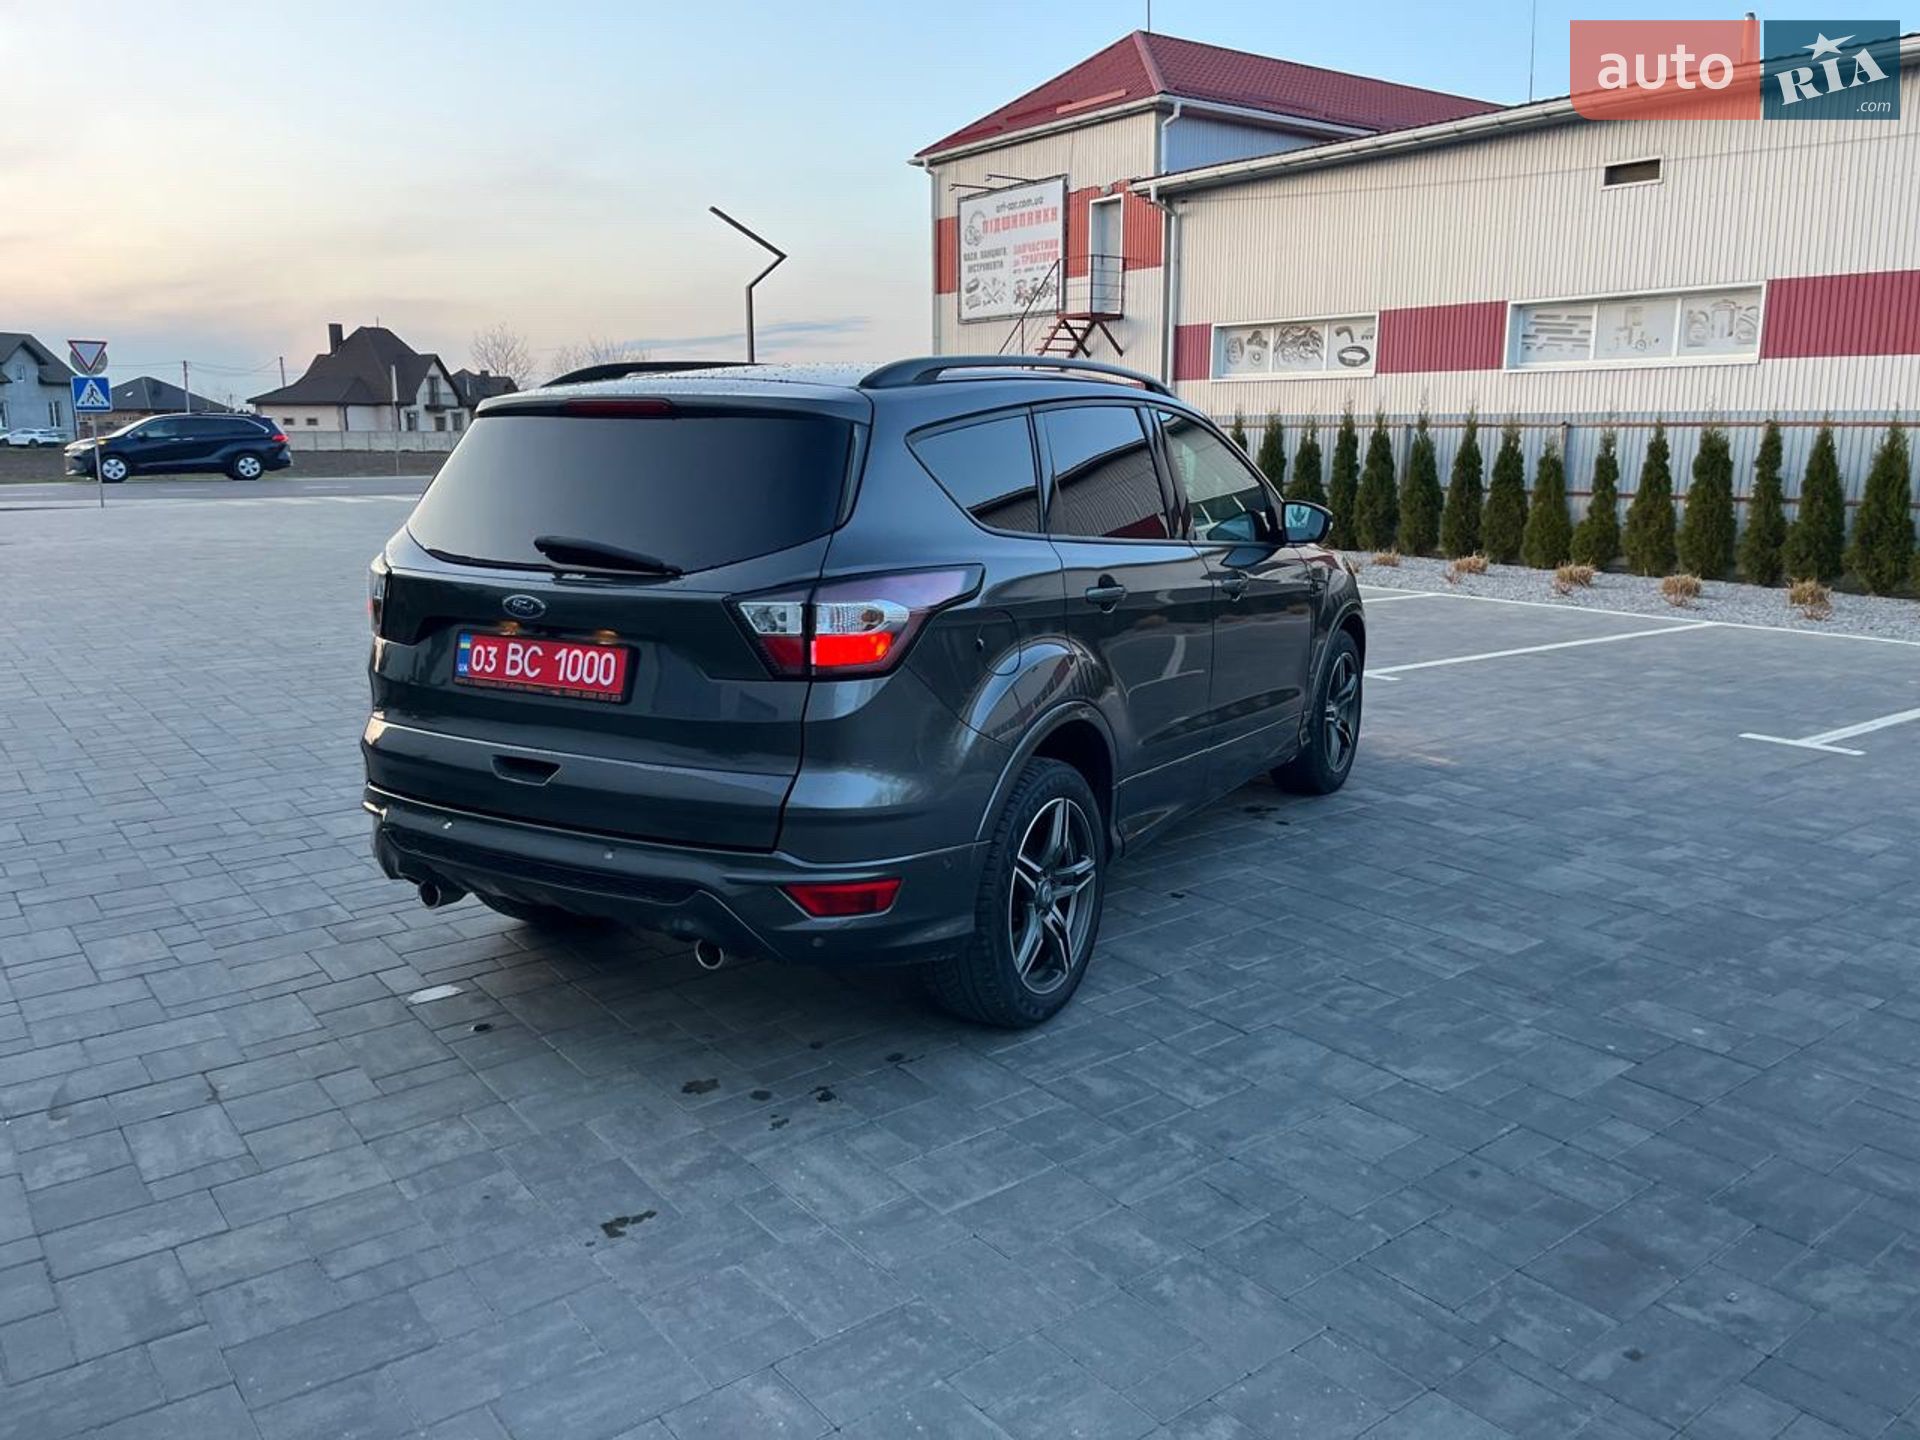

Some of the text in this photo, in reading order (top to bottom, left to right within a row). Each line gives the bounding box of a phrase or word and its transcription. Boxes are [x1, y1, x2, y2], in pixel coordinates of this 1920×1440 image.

[471, 642, 616, 686] 03 BC 1000
